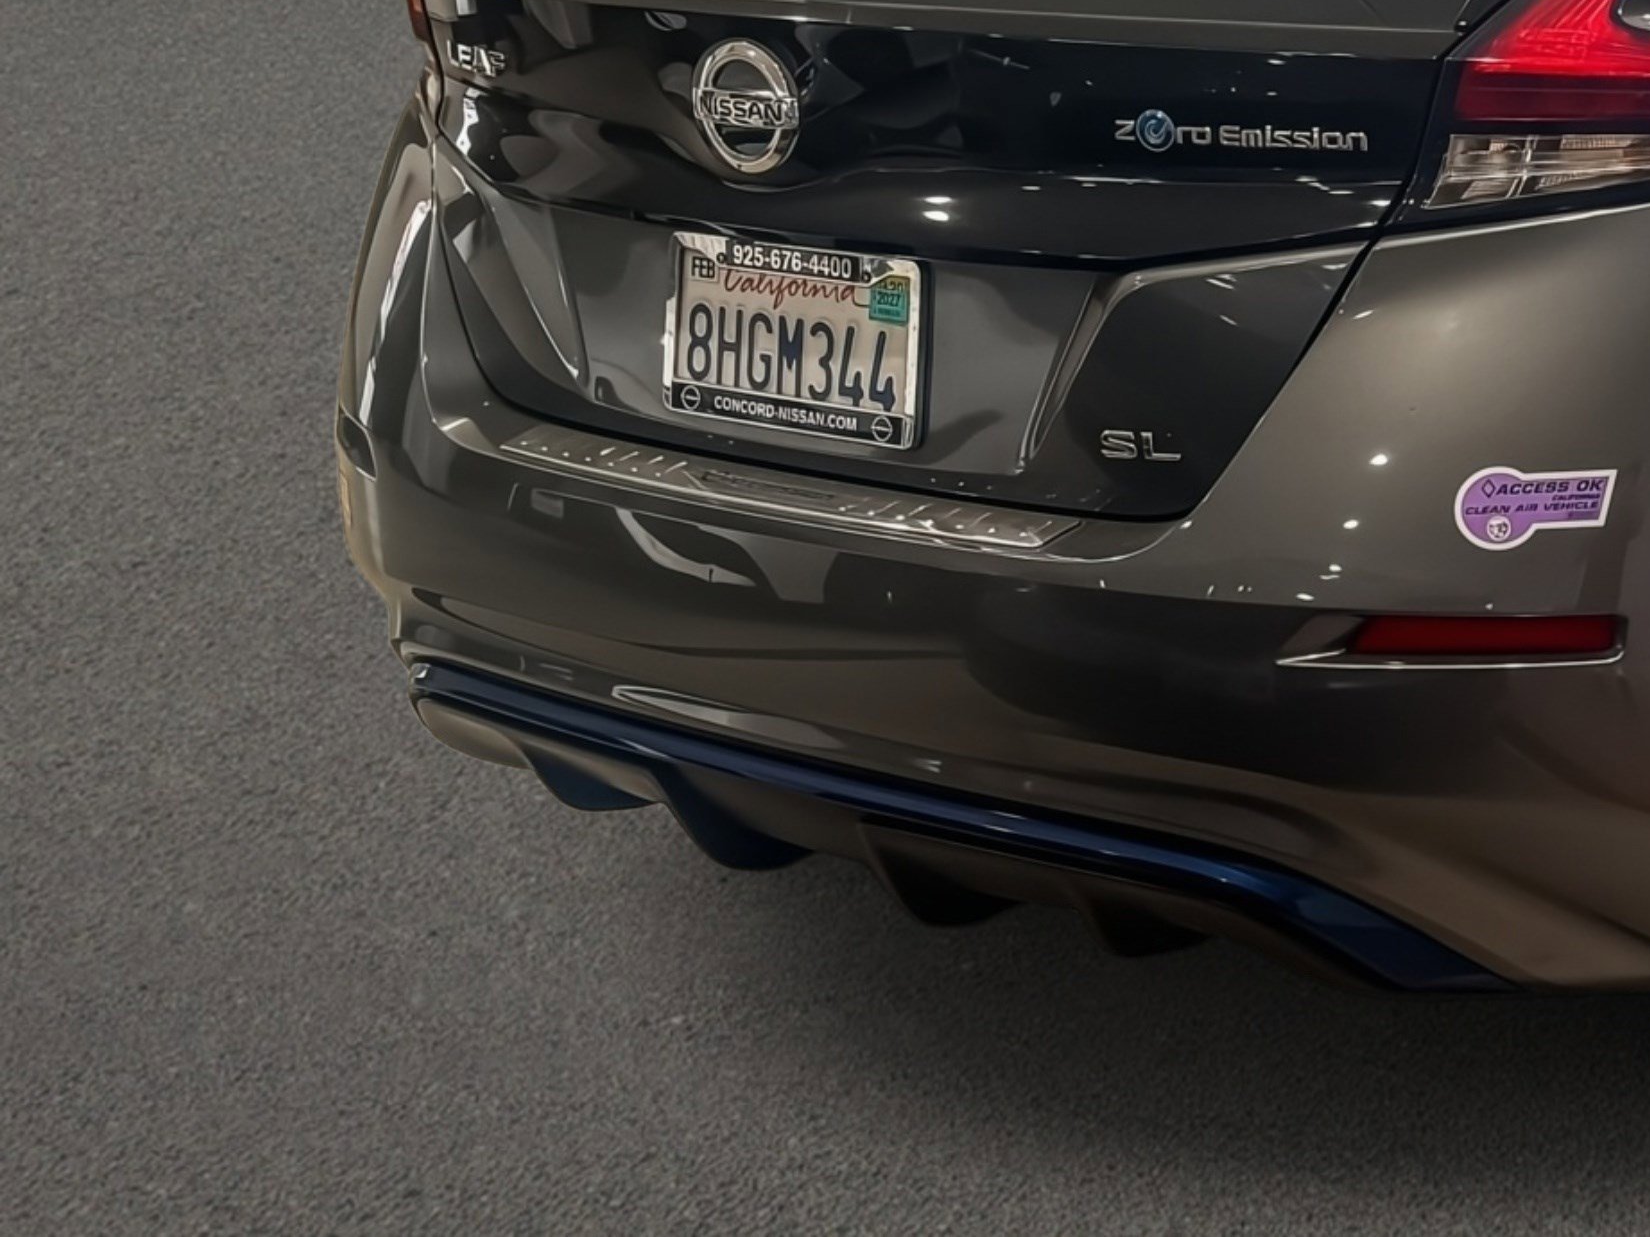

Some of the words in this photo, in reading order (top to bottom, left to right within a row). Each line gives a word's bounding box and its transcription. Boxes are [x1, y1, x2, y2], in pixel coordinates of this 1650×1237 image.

[700, 90, 783, 123] NISSAN
[1219, 124, 1369, 152] Emission
[733, 244, 852, 279] 925-676-4400
[724, 268, 856, 310] California
[687, 303, 896, 412] 8HGM344
[714, 395, 858, 431] CONCORD-NISSAN.COM
[1100, 429, 1182, 461] SL
[1496, 480, 1571, 496] ACCESS
[1577, 479, 1604, 492] OK
[1464, 505, 1510, 516] CLEAN
[1513, 503, 1539, 512] AIR
[1543, 500, 1599, 512] VEHICLE
